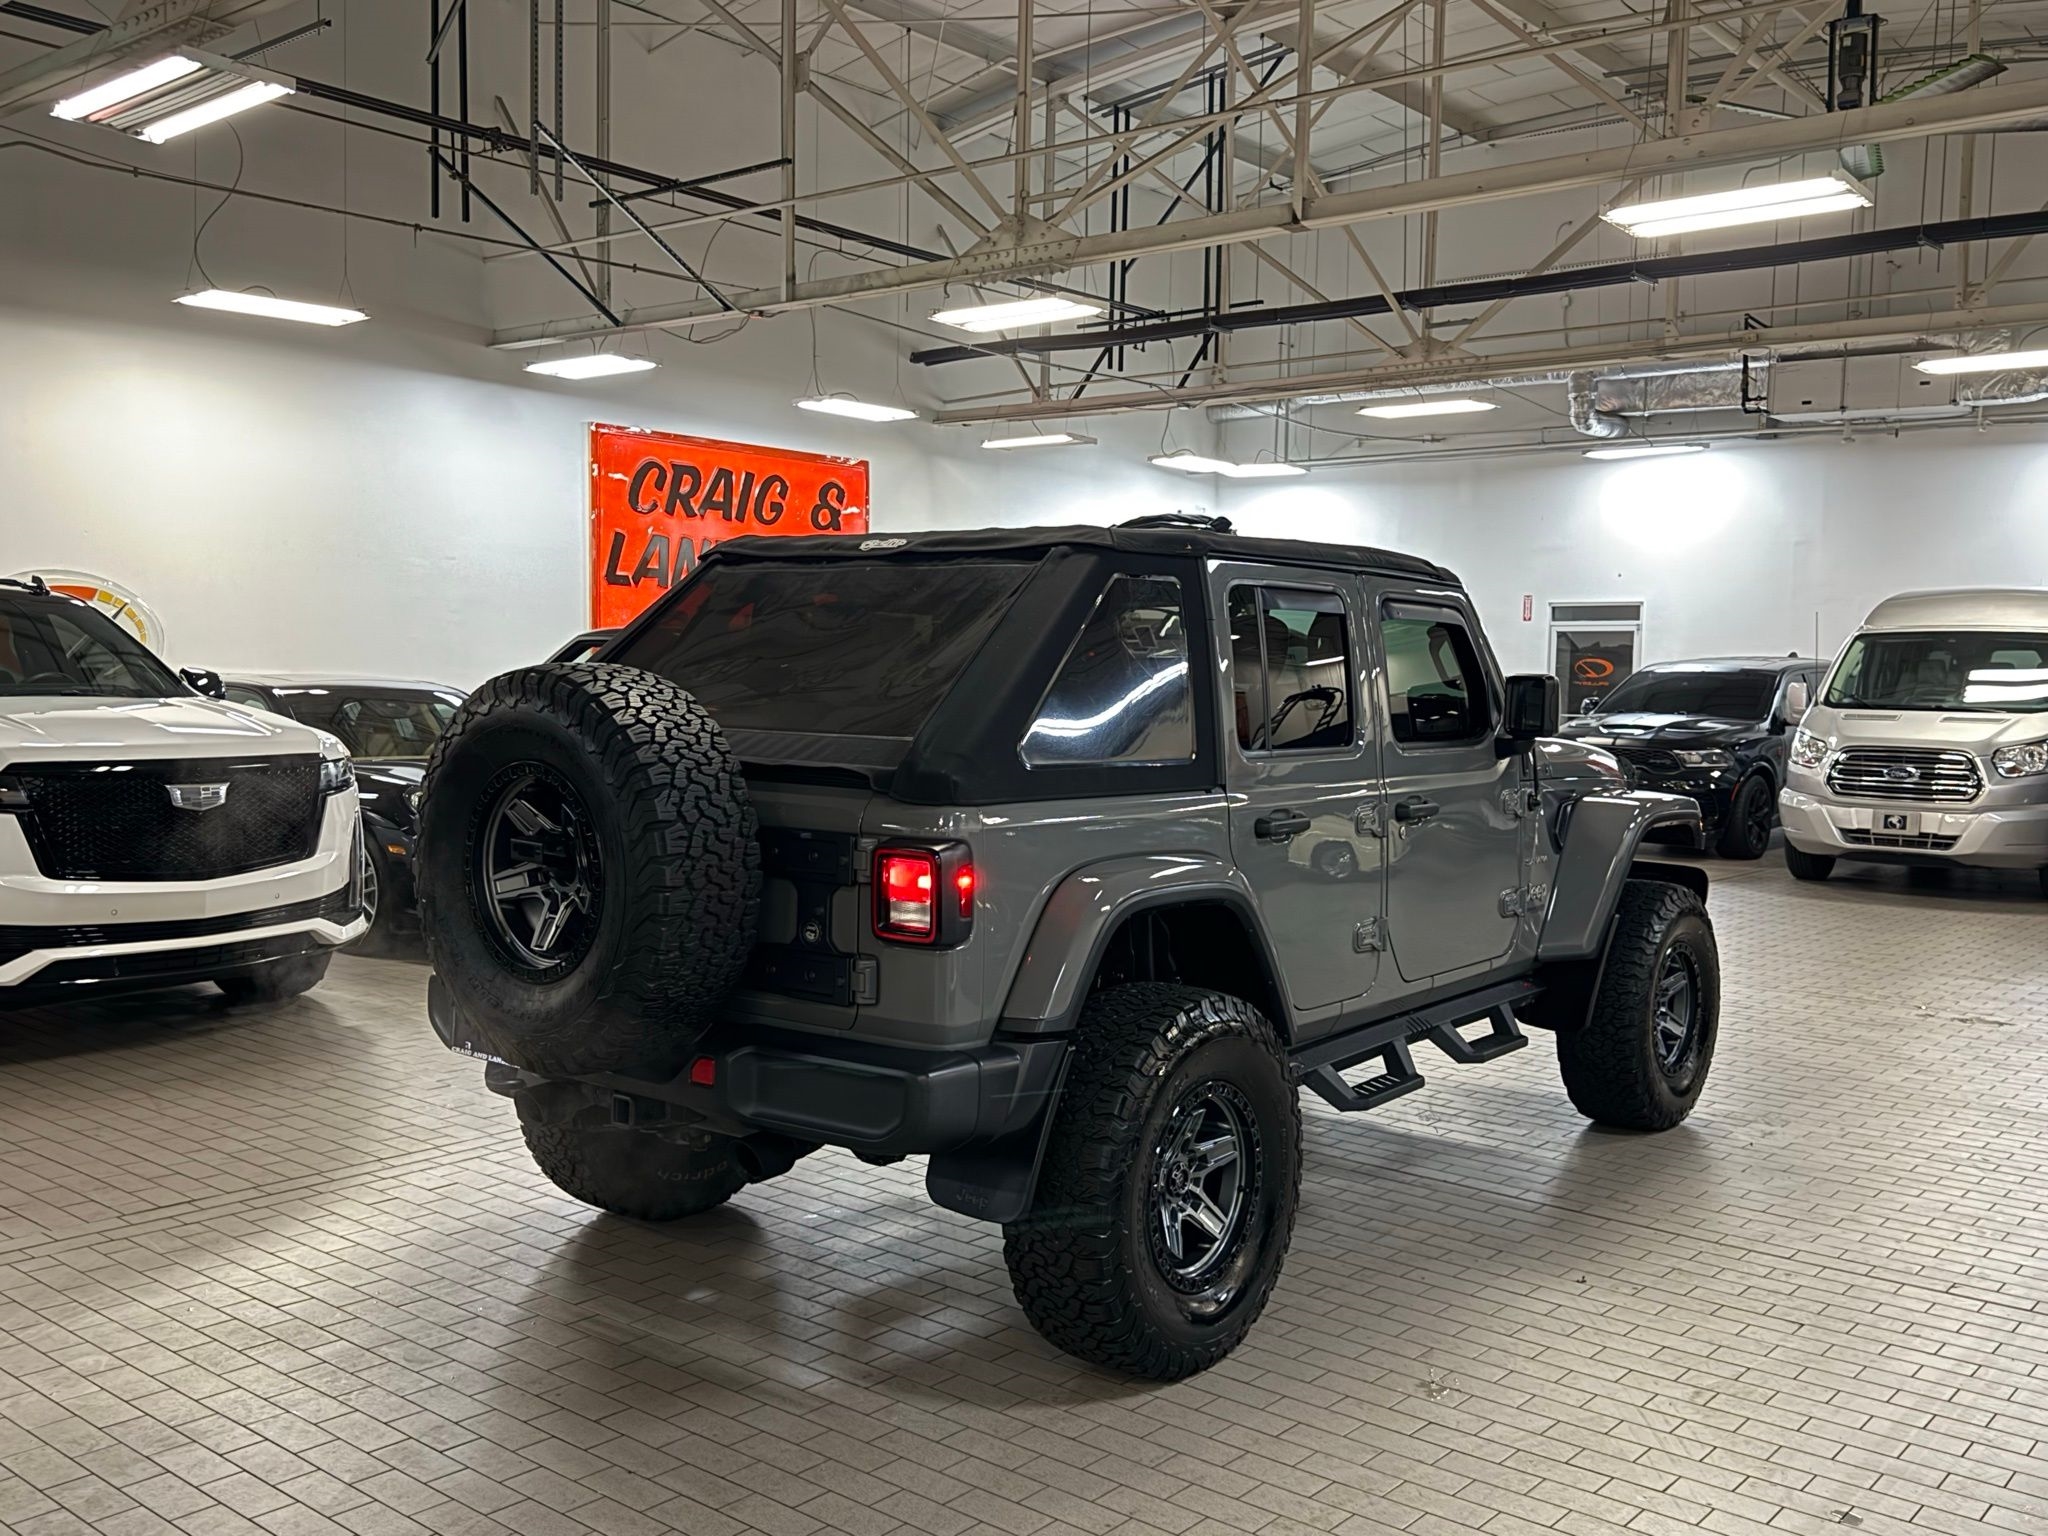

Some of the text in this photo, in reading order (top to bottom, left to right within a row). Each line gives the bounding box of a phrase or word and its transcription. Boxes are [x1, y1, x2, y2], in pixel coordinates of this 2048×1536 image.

[628, 460, 846, 532] CRAIG &
[605, 531, 718, 589] LAN
[451, 1046, 472, 1055] CRAIG
[472, 1051, 488, 1060] AND
